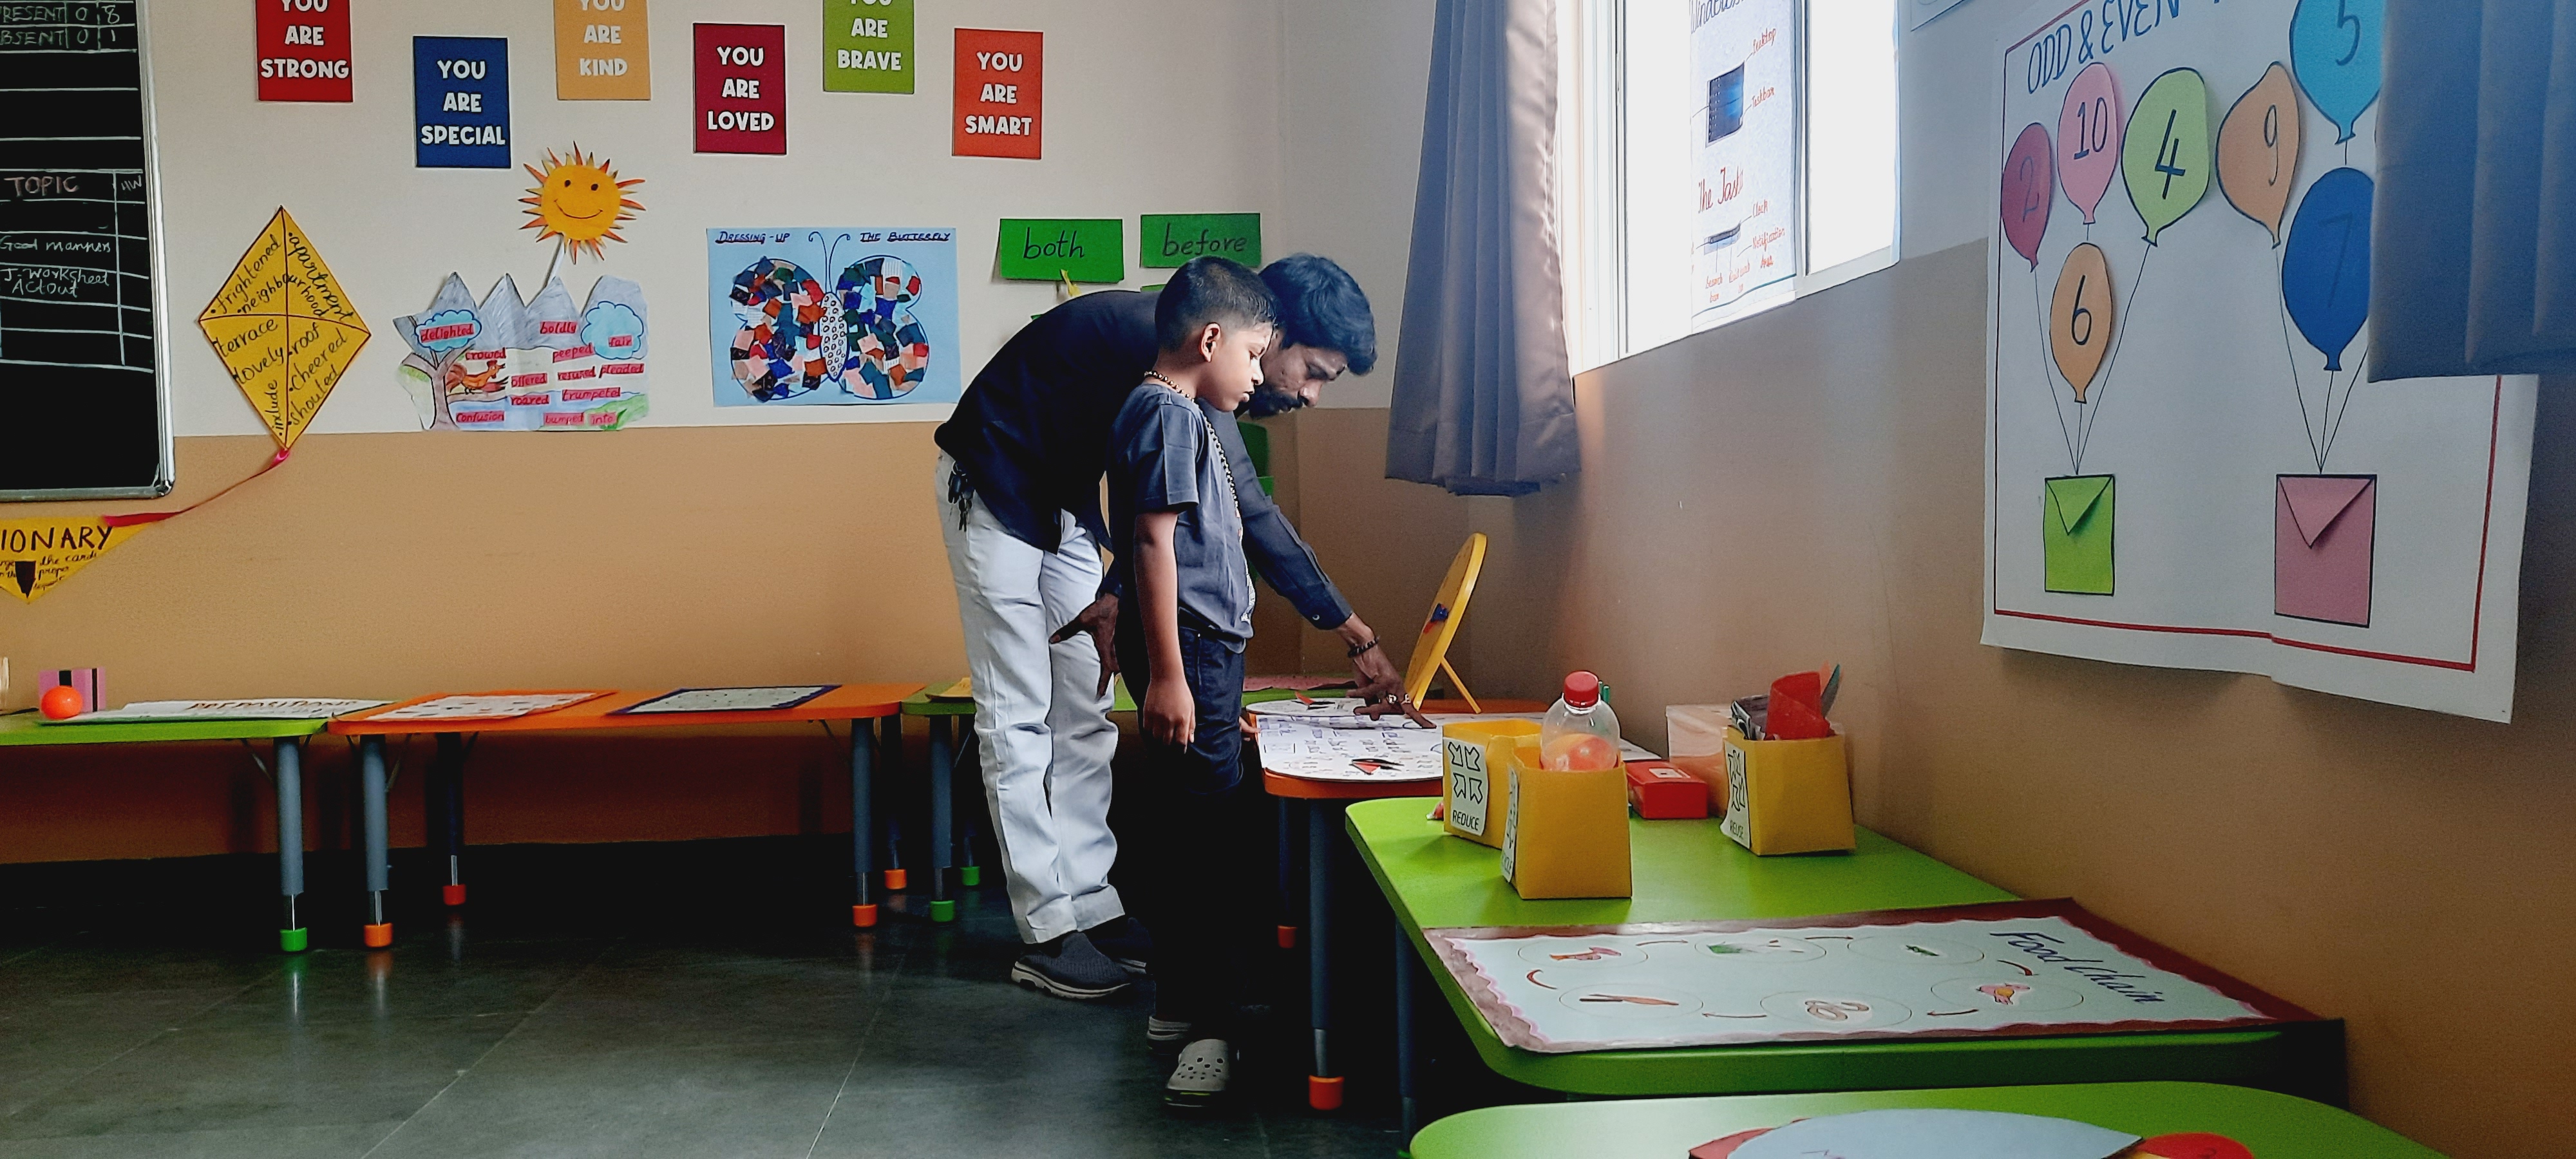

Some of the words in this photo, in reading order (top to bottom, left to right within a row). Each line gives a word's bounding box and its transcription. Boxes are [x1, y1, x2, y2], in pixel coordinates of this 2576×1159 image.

[0, 5, 64, 23] RESENT
[75, 7, 88, 21] 0
[0, 30, 64, 46] BSENT
[285, 26, 325, 46] ARE
[584, 24, 621, 44] ARE
[851, 18, 888, 38] ARE
[2335, 0, 2360, 66] 5
[716, 46, 764, 66] YOU
[837, 50, 902, 71] BRAVE
[976, 52, 1023, 72] YOU
[2028, 24, 2071, 94] ODD
[2078, 10, 2093, 64] &
[260, 58, 350, 79] STRONG
[437, 60, 486, 80] YOU
[580, 58, 628, 77] KIND
[721, 79, 760, 99] ARE
[980, 84, 1017, 104] ARE
[443, 92, 482, 113] ARE
[707, 111, 774, 131] LOVED
[965, 116, 1032, 136] SMART
[2074, 97, 2108, 160] 10
[421, 126, 506, 146] SPECIAL
[2262, 104, 2278, 186] 9
[2155, 108, 2186, 200] 4
[3, 176, 80, 197] TOPIC
[2018, 156, 2039, 223] 2
[860, 232, 881, 242] THE
[887, 232, 951, 242] BUTTERFLY
[1023, 227, 1084, 259] both
[1163, 222, 1247, 257] before
[2321, 214, 2352, 308] 7
[216, 234, 281, 314] frightened
[289, 236, 354, 322] apartment
[2071, 274, 2092, 346] 6
[421, 324, 473, 343] delighted
[540, 321, 577, 334] boldly
[216, 319, 278, 358] terrace
[291, 322, 321, 356] roof
[609, 336, 632, 346] fair
[553, 343, 592, 363] peeped
[235, 346, 285, 386] lovely
[599, 364, 644, 379] pleaded
[511, 373, 547, 387] offered
[511, 395, 549, 405] roared
[1453, 810, 1479, 831] REDUCE
[1989, 932, 2103, 963] Food
